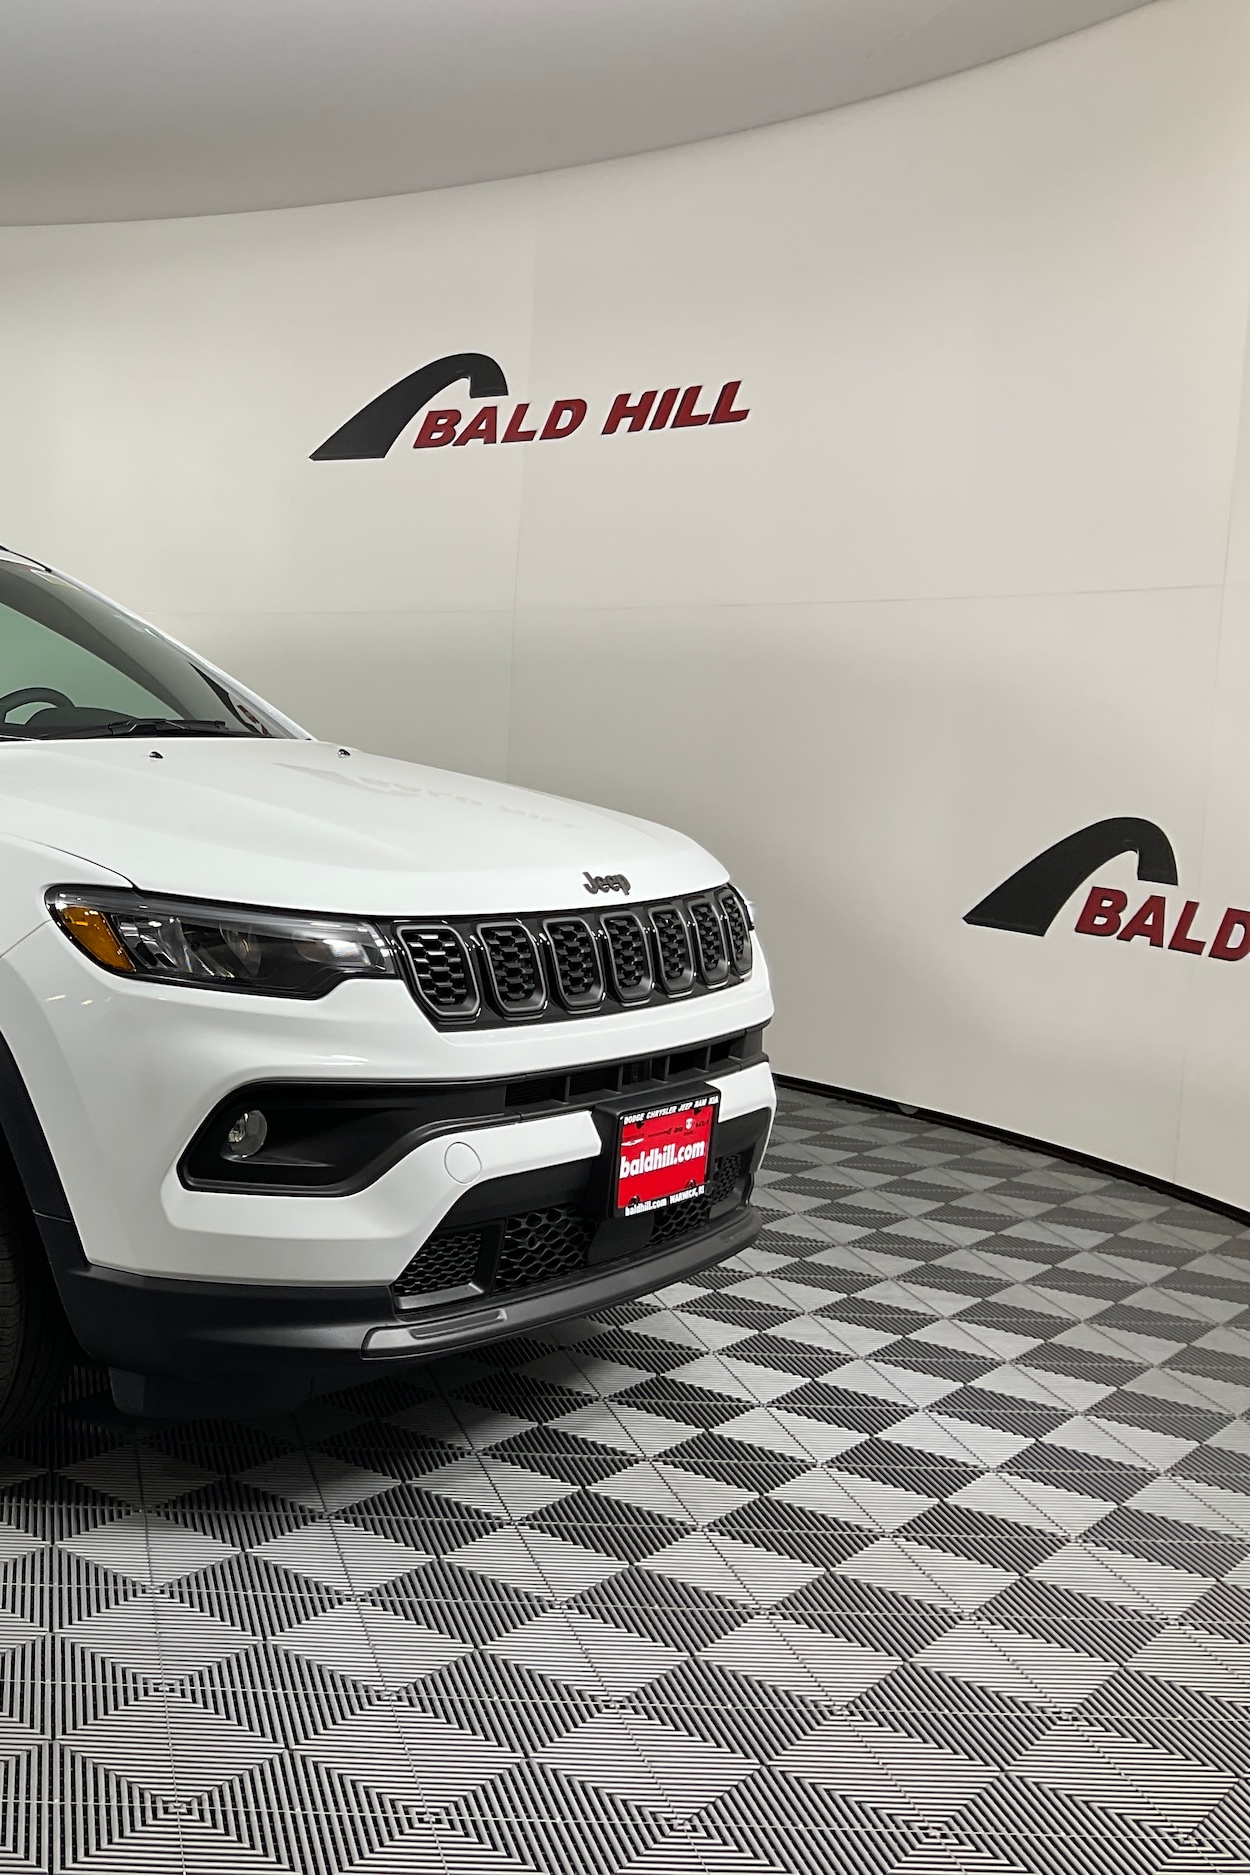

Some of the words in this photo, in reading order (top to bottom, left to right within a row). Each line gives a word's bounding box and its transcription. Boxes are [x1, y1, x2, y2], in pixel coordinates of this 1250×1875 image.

[413, 398, 588, 449] BALD
[601, 380, 750, 436] HILL
[582, 871, 631, 896] Jeep
[1074, 886, 1250, 962] BALD
[624, 1112, 645, 1125] DODGE
[646, 1105, 677, 1119] CHRYSLER
[678, 1101, 693, 1112] JEEP
[694, 1098, 707, 1108] RAM
[708, 1096, 719, 1105] KIA
[619, 1140, 705, 1179] baldhill.com
[625, 1198, 667, 1216] baldhill.com
